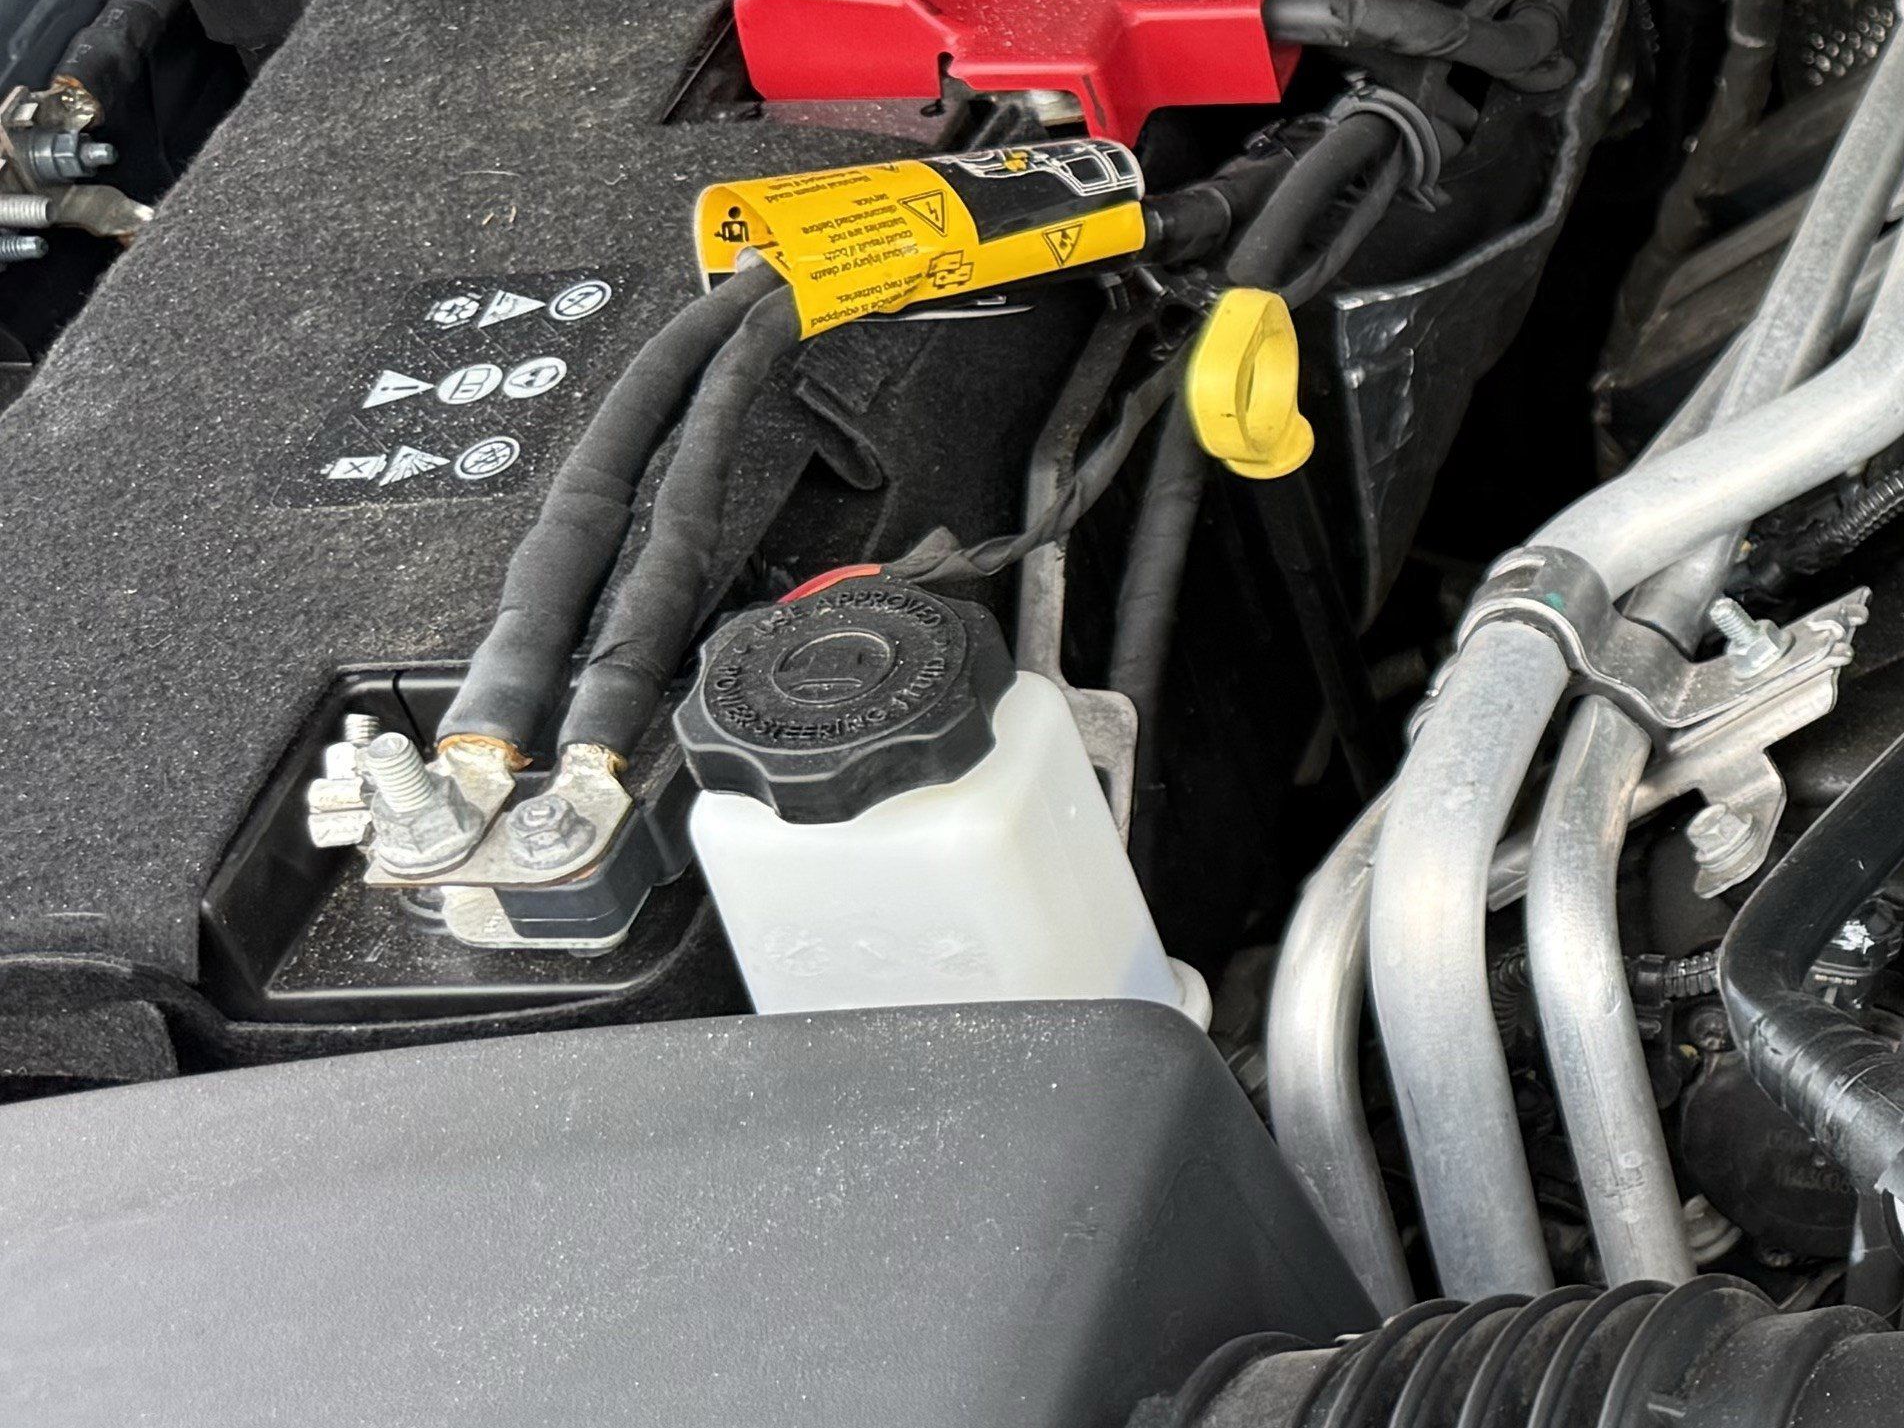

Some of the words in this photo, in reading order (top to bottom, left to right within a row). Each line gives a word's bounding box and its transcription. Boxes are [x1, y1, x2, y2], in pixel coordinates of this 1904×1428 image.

[810, 266, 839, 281] death
[840, 262, 851, 273] or
[814, 590, 943, 627] APPROVED
